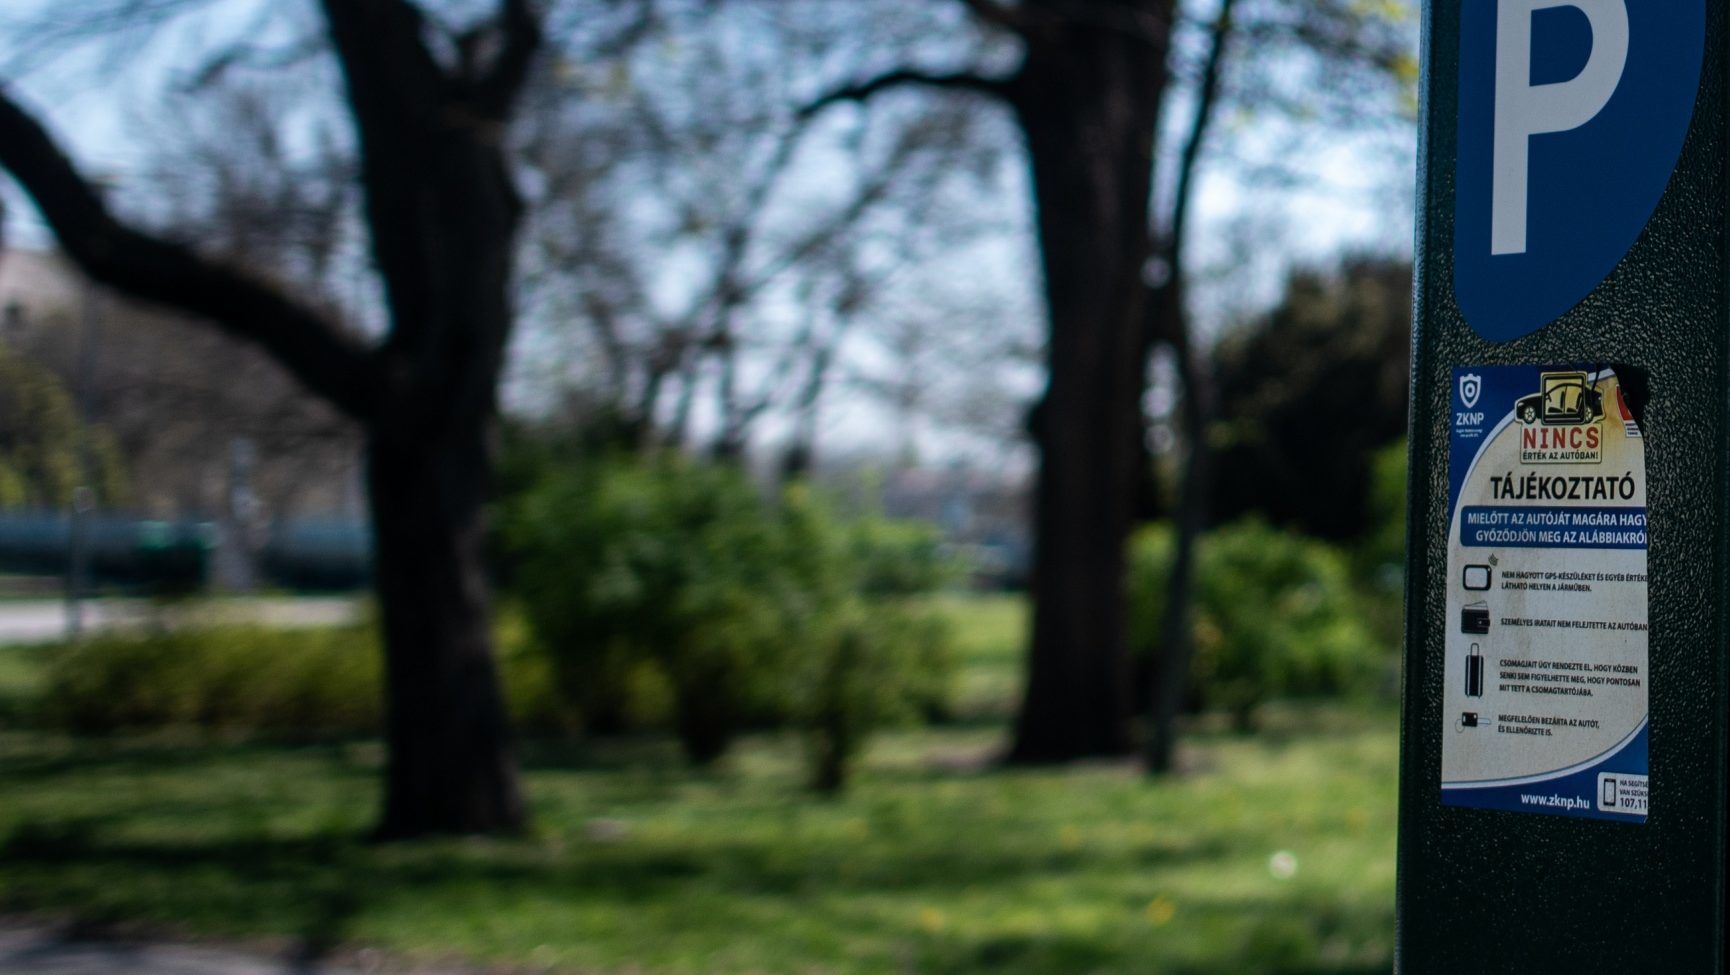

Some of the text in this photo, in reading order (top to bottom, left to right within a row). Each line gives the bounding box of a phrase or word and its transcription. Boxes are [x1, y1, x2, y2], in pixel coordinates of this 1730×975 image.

[1456, 413, 1484, 425] ZKNP
[1524, 427, 1598, 449] NINCS
[1523, 451, 1546, 460] ÉRTÉK
[1560, 449, 1598, 459] AUTÓBAN!
[1490, 471, 1634, 500] TÁJÉKOZTATÓ
[1468, 511, 1509, 524] MIELŐTT
[1511, 513, 1524, 524] AZ
[1526, 512, 1570, 525] AUTÓJÁT
[1573, 512, 1617, 525] MAGÁRA
[1476, 528, 1536, 542] GYŐZŐDJÖN
[1539, 531, 1560, 542] MEG
[1563, 532, 1576, 543] AZ
[1545, 572, 1595, 580] GPS-KÉSZÜLÉKET
[1605, 573, 1624, 581] EGYÉB
[1502, 581, 1527, 590] LÁTHATÓ
[1557, 583, 1592, 592] JÁRMŰBEN.
[1501, 618, 1533, 626] SZEMÉLYES
[1572, 621, 1606, 629] FELEJTETTE
[1617, 622, 1647, 630] AUTÓBAN
[1500, 660, 1537, 668] CSOMAGJAIT
[1552, 662, 1582, 670] RENDEZTE
[1613, 664, 1637, 673] KÖZBEN
[1531, 673, 1569, 682] FIGYELHETTE
[1606, 678, 1640, 686] PONTOSAN
[1531, 686, 1593, 696] CSOMAGTARTÓJÁBA.
[1498, 715, 1540, 724] MEGFELELŐEN
[1541, 717, 1568, 725] BEZÁRTA
[1578, 720, 1599, 728] AUTÓT,
[1506, 726, 1544, 735] ELLENŐRIZTE
[1521, 794, 1589, 810] www.zknp.hu
